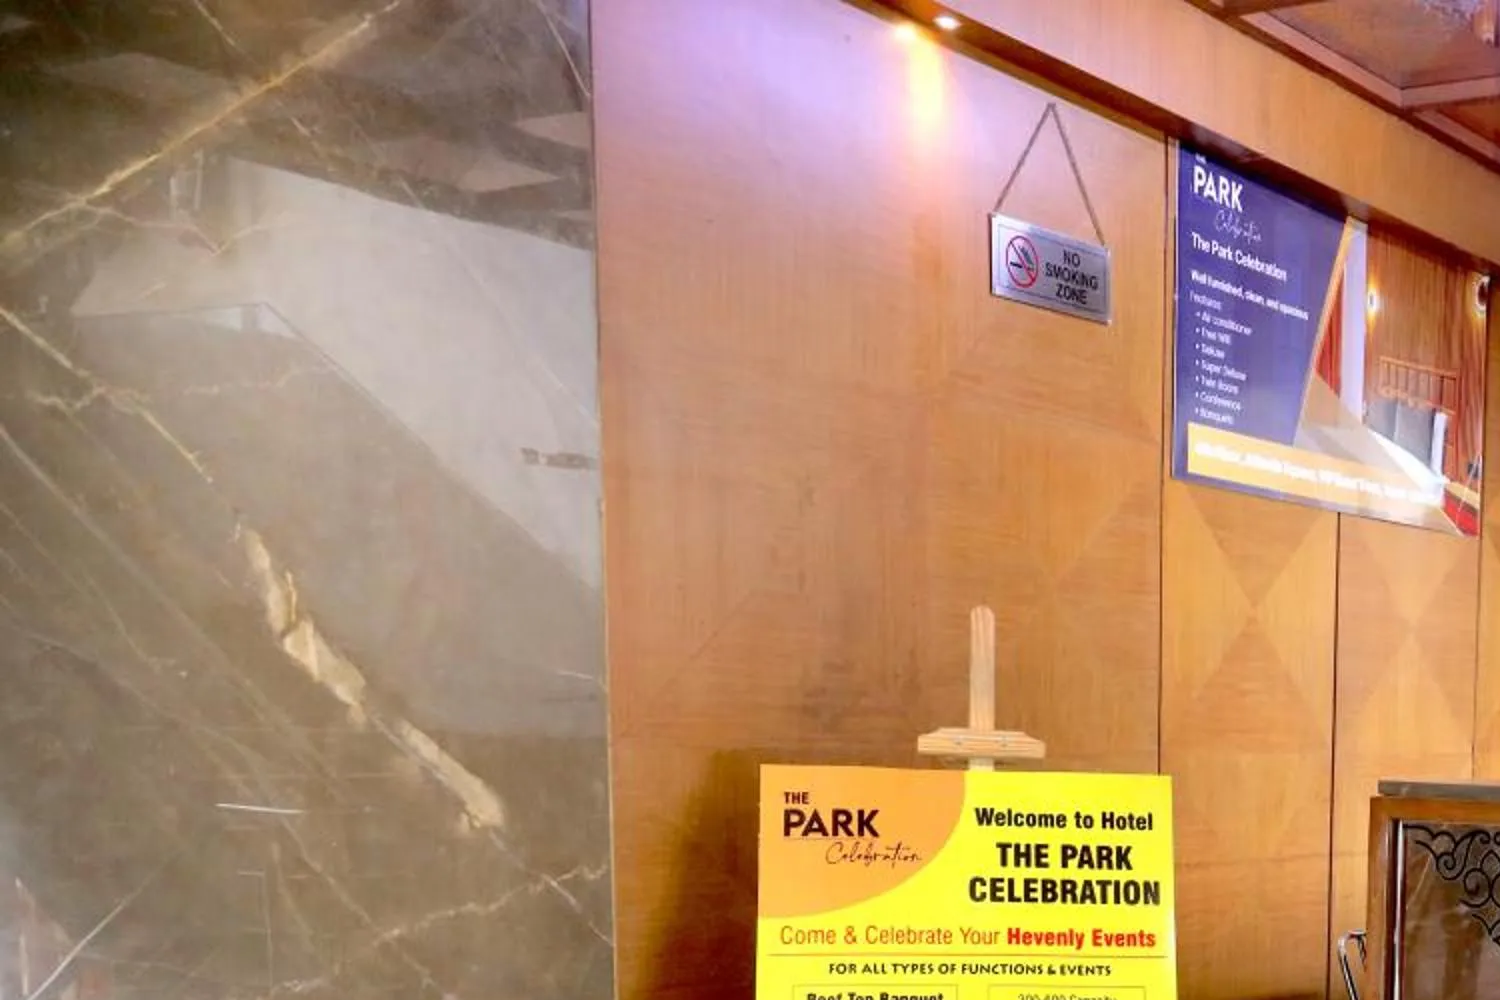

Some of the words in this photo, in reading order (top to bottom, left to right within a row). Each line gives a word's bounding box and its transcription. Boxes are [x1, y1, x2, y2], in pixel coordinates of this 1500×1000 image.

[1193, 165, 1243, 213] PARK
[1063, 249, 1081, 267] NO
[1191, 231, 1210, 253] The
[1212, 240, 1233, 261] Park
[1235, 249, 1287, 282] Celebration
[1045, 261, 1099, 291] SMOKING
[1056, 283, 1088, 305] ZONE
[784, 791, 810, 804] THE
[784, 809, 880, 838] PARK
[975, 807, 1067, 829] Welcome
[1074, 811, 1094, 829] to
[1101, 811, 1153, 831] Hotel
[825, 840, 923, 869] Celebration
[996, 842, 1050, 869] THE
[1060, 844, 1133, 871] PARK
[968, 876, 1161, 906] CELEBRATION
[780, 925, 837, 945] Come
[844, 925, 857, 945] &
[865, 925, 953, 945] Celebrate
[959, 927, 1000, 945] Your
[1007, 927, 1084, 950] Hevenly
[1092, 928, 1156, 947] Events
[829, 963, 857, 975] FOR
[861, 963, 887, 975] ALL
[892, 963, 934, 975] TYPES
[937, 963, 957, 975] OF
[961, 963, 1043, 976] FUNCTIONS
[1046, 964, 1056, 976] &
[1059, 964, 1112, 977] EVENTS
